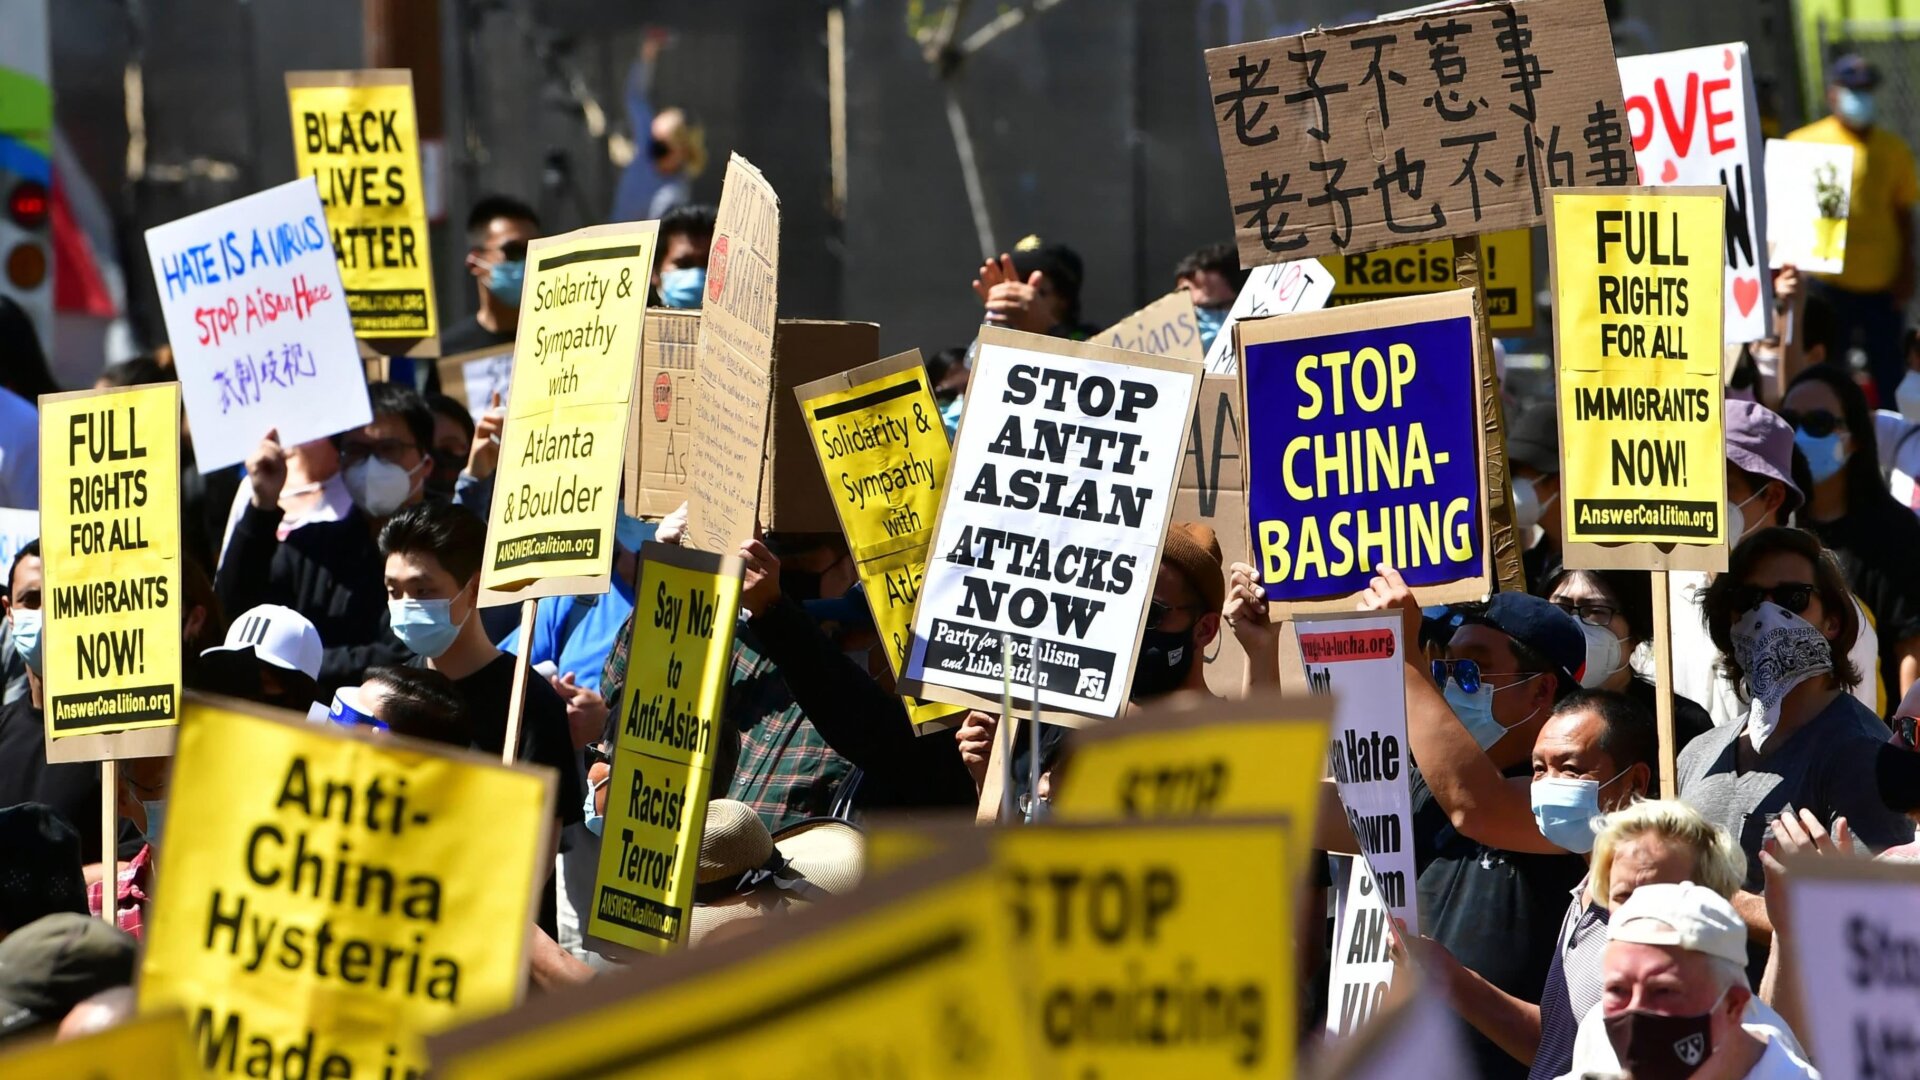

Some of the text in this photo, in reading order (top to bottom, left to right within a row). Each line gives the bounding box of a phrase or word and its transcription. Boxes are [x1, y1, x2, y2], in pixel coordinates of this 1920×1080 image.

[1214, 15, 1553, 146] 老子不惹事
[304, 110, 403, 155] BLACK
[1625, 71, 1736, 158] OVE
[1235, 101, 1634, 252] 老子也不怕事
[161, 215, 326, 301] HATE IS A VIRUS
[331, 225, 418, 270] ATTER
[1596, 210, 1689, 266] FULL
[534, 267, 633, 312] Solidarity &
[1344, 246, 1496, 285] Racis!
[195, 297, 239, 346] STOP
[1599, 275, 1689, 317] RIGHTS
[534, 315, 617, 367] Sympathy
[1601, 323, 1689, 360] FOR ALL
[548, 367, 579, 397] with
[1002, 363, 1159, 423] STOP
[1295, 343, 1417, 420] STOP
[1574, 387, 1709, 423] IMMIGRANTS
[69, 407, 147, 466] FULL
[521, 424, 594, 467] Atlanta
[821, 401, 932, 461] Solidarity &
[987, 414, 1149, 475] ANTI-
[841, 451, 936, 510] Sympathy
[1282, 422, 1450, 501] CHINA-
[1611, 439, 1688, 488] NOW!
[70, 469, 147, 515] RIGHTS
[503, 474, 603, 525] & Boulder
[963, 462, 1153, 528] ASIAN
[1579, 503, 1714, 532] AnswerCoalition.org
[70, 522, 105, 556] FOR
[109, 517, 149, 552] ALL
[497, 535, 595, 563] ANSWERCoalition.org
[882, 507, 922, 539] with
[1258, 497, 1474, 584] BASHING
[885, 562, 924, 609] Atla
[946, 524, 1138, 596] ATTACKS
[53, 575, 168, 620] IMMIGRANTS
[654, 580, 721, 645] Say No!
[955, 575, 1106, 640] NOW
[76, 628, 145, 681] NOW!
[934, 621, 979, 653] Party
[977, 632, 998, 652] for
[666, 651, 683, 690] to
[941, 652, 1049, 687] and Libeation
[1074, 674, 1106, 700] PSL
[56, 692, 171, 721] AnswerCoalition.org
[625, 688, 712, 756] Anti-Asian
[1344, 729, 1400, 784] Hate
[275, 755, 431, 835] Anti-
[628, 768, 687, 833] Racist
[245, 824, 441, 923] China
[617, 828, 680, 893] Terror!
[203, 889, 461, 1006] Hysteria
[1043, 957, 1267, 1068] onizing
[195, 1006, 353, 1080] Made
